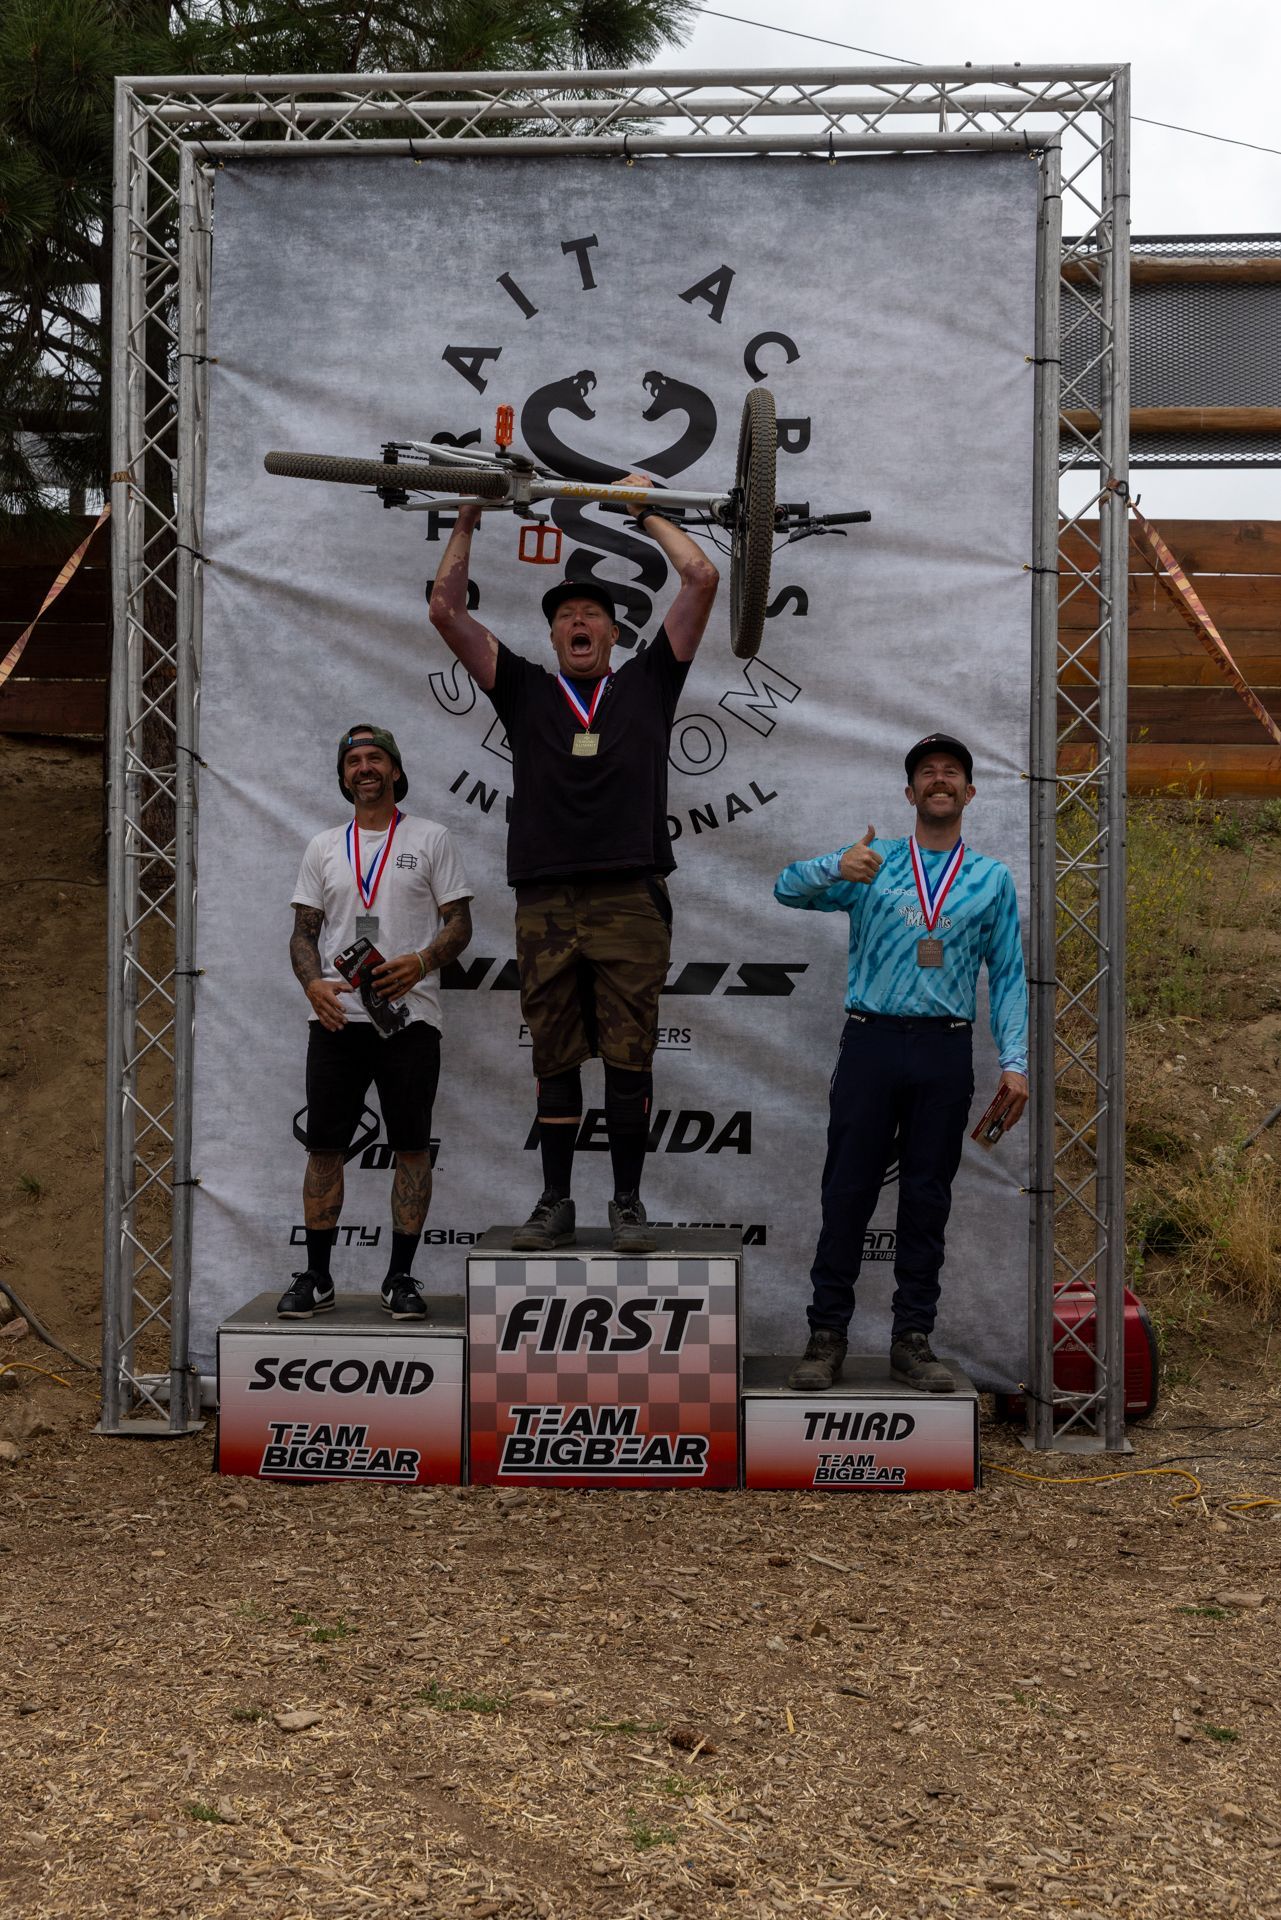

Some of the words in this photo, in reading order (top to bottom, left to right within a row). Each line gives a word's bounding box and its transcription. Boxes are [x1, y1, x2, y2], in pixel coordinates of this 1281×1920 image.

[289, 1225, 381, 1247] DTY
[501, 1297, 703, 1352] FIRST
[248, 1358, 434, 1395] SECOND
[509, 1406, 639, 1435] TEAM
[803, 1412, 915, 1441] THIRD
[270, 1423, 367, 1447] TEAM
[261, 1446, 419, 1472] BIGBEAR
[501, 1434, 709, 1466] BIGBEAR
[818, 1454, 876, 1468] TEAM
[815, 1466, 906, 1482] BIGBEAR
